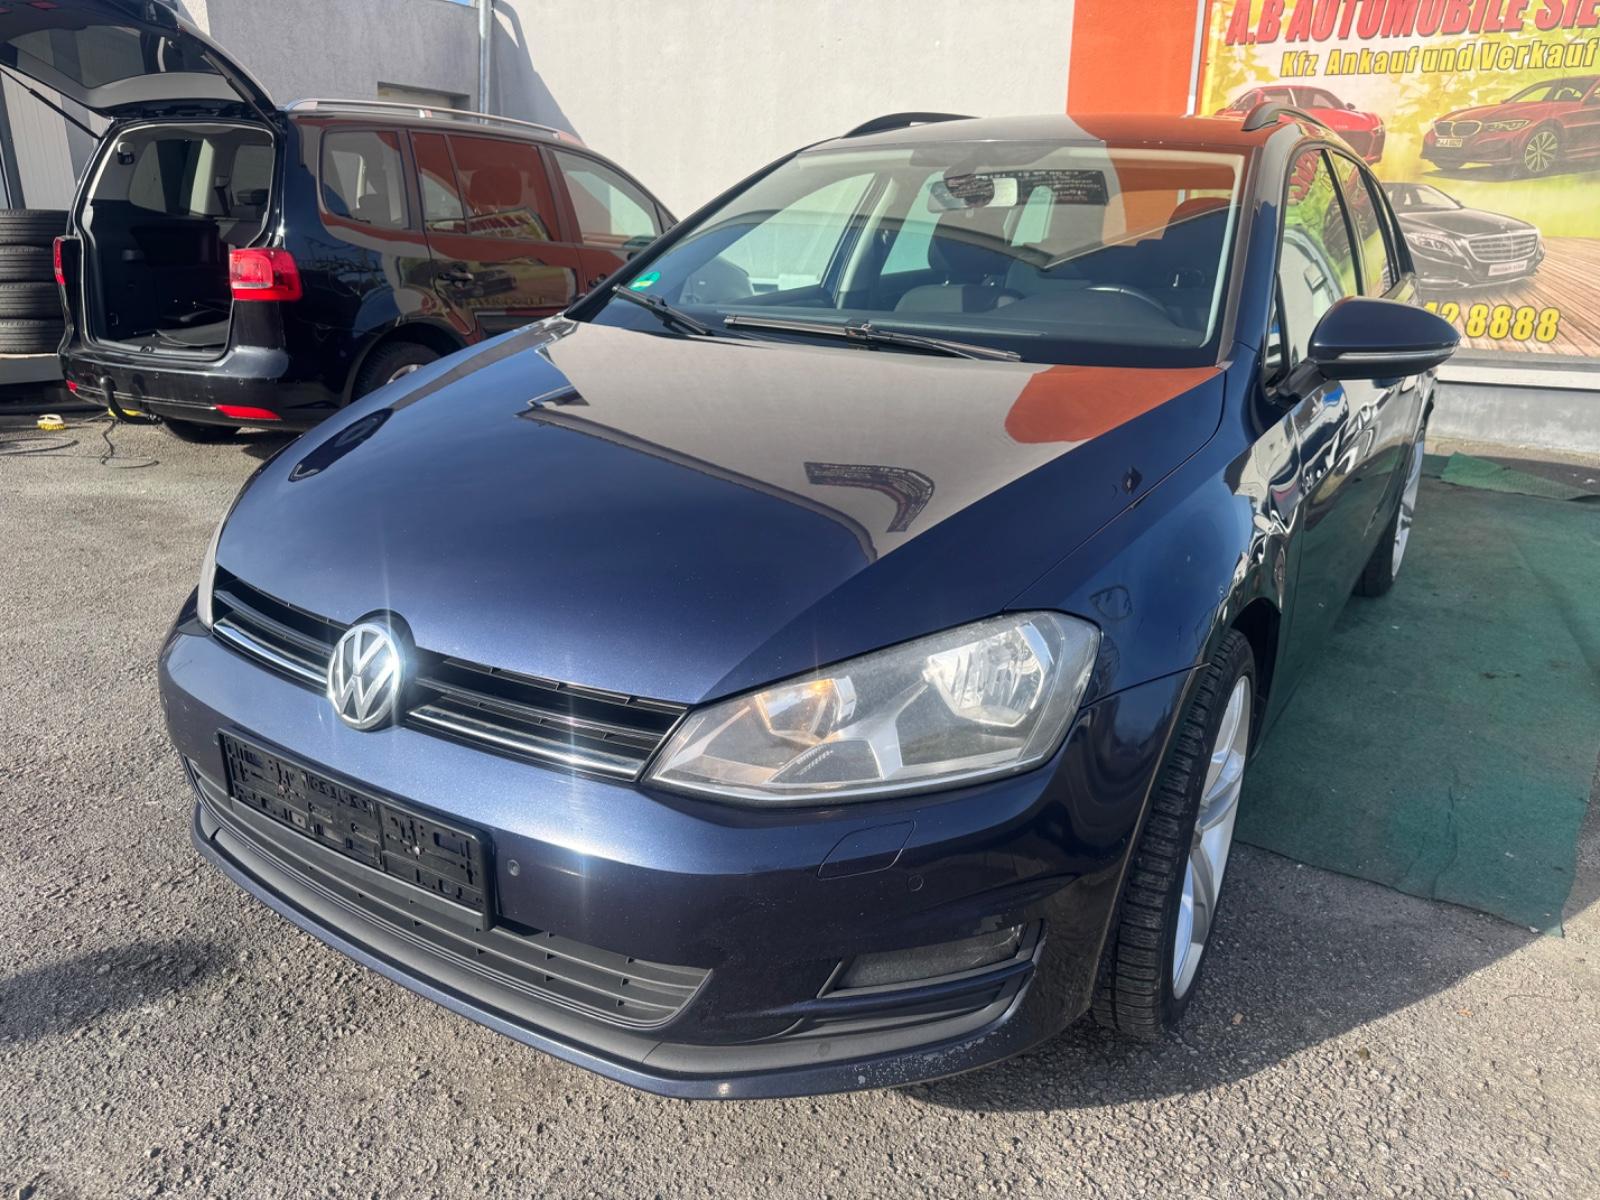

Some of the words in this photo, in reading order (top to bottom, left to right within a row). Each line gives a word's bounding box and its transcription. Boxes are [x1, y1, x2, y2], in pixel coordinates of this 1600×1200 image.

[1285, 0, 1529, 42] AUTOMOBILE
[1280, 51, 1319, 78] Kfz
[1324, 46, 1420, 76] Ankauf
[1421, 43, 1475, 73] und
[1479, 37, 1600, 71] Verkauf
[1465, 303, 1561, 343] 8888
